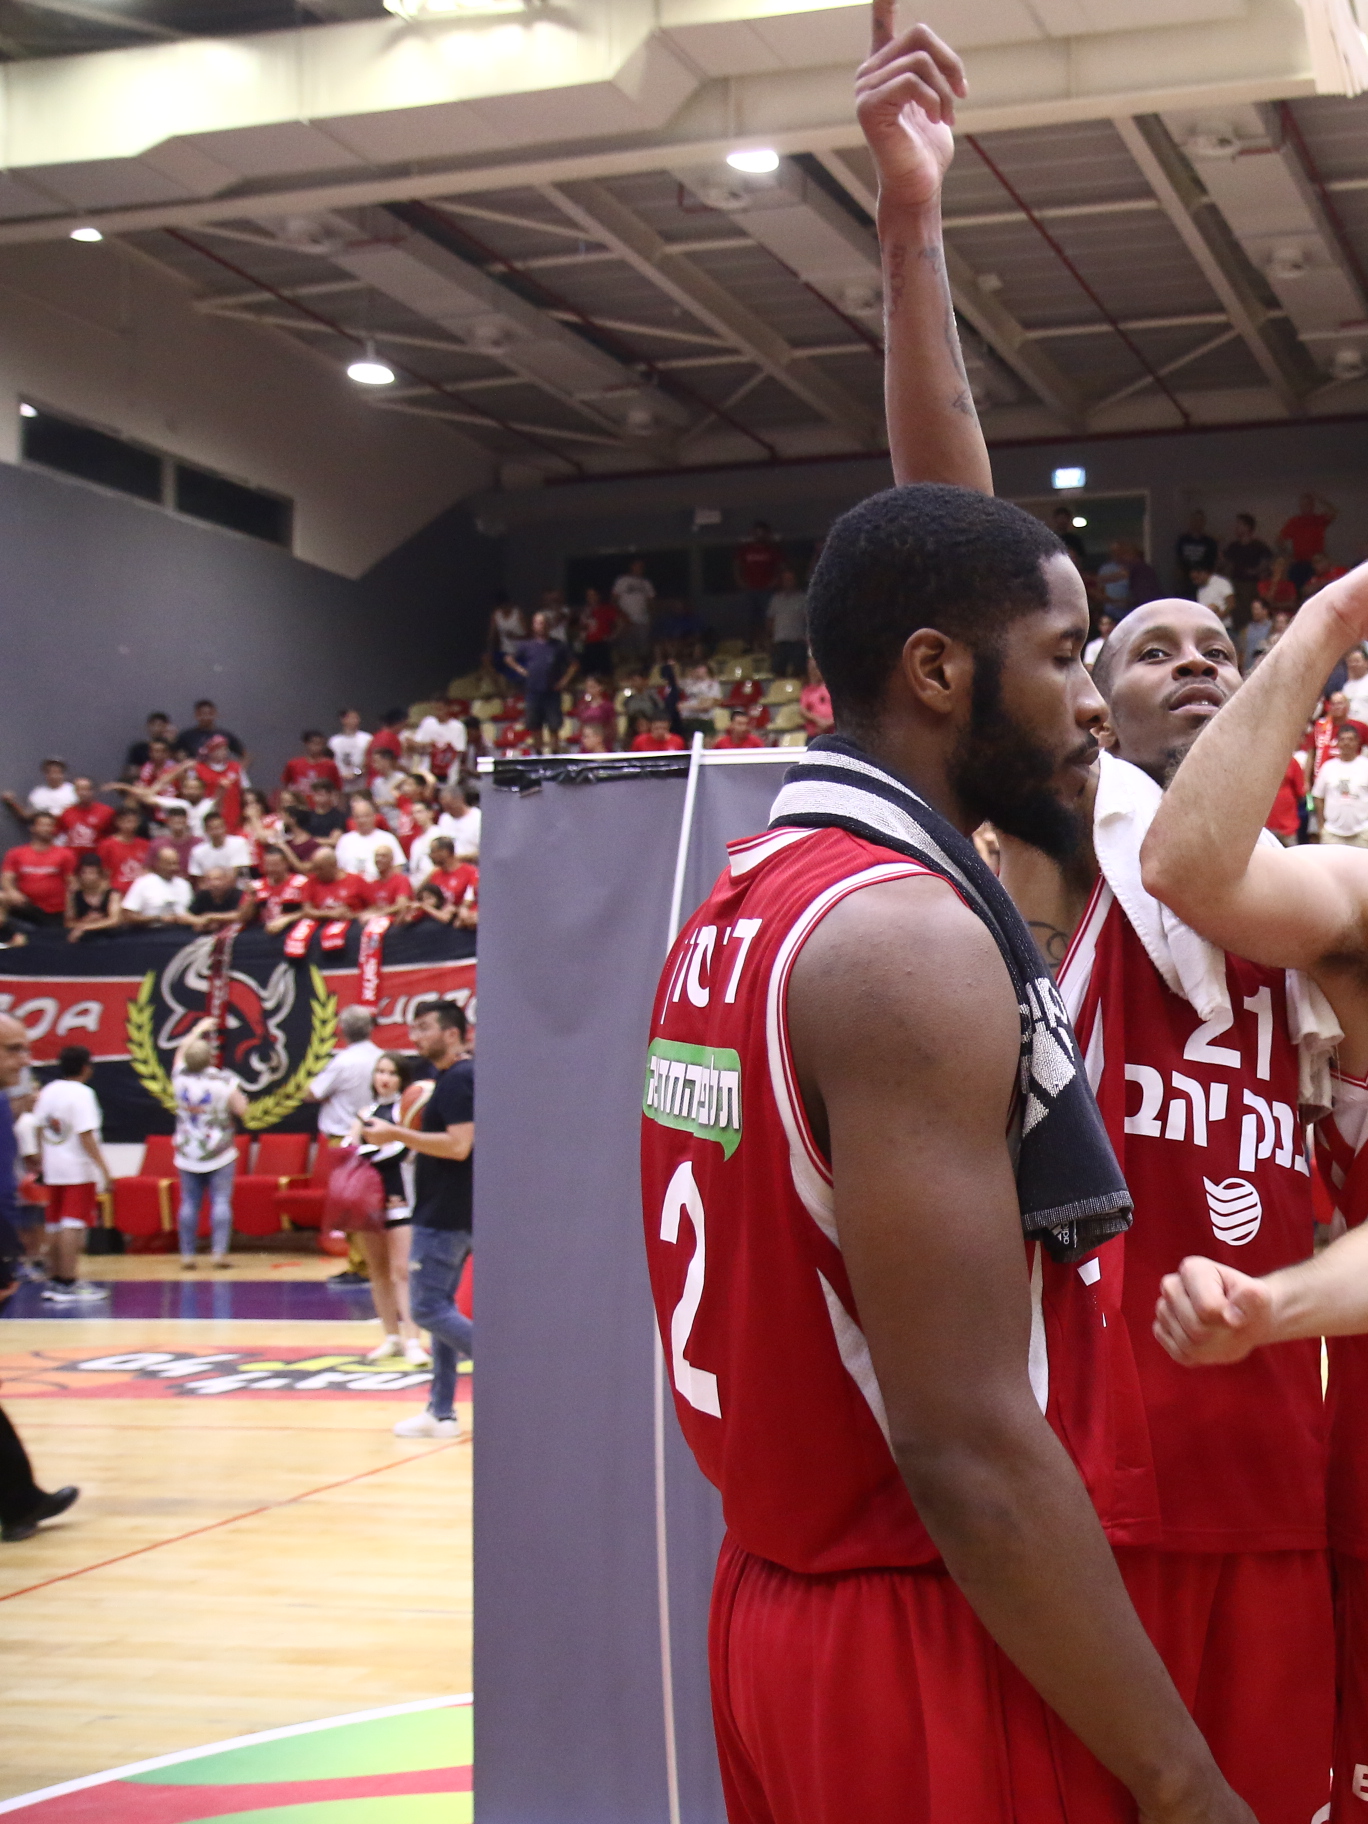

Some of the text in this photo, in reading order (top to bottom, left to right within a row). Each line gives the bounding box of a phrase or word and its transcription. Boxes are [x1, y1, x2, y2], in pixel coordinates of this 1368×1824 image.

[1183, 986, 1273, 1081] 21
[1124, 1063, 1229, 1147] יהב
[660, 1161, 722, 1419] 2
